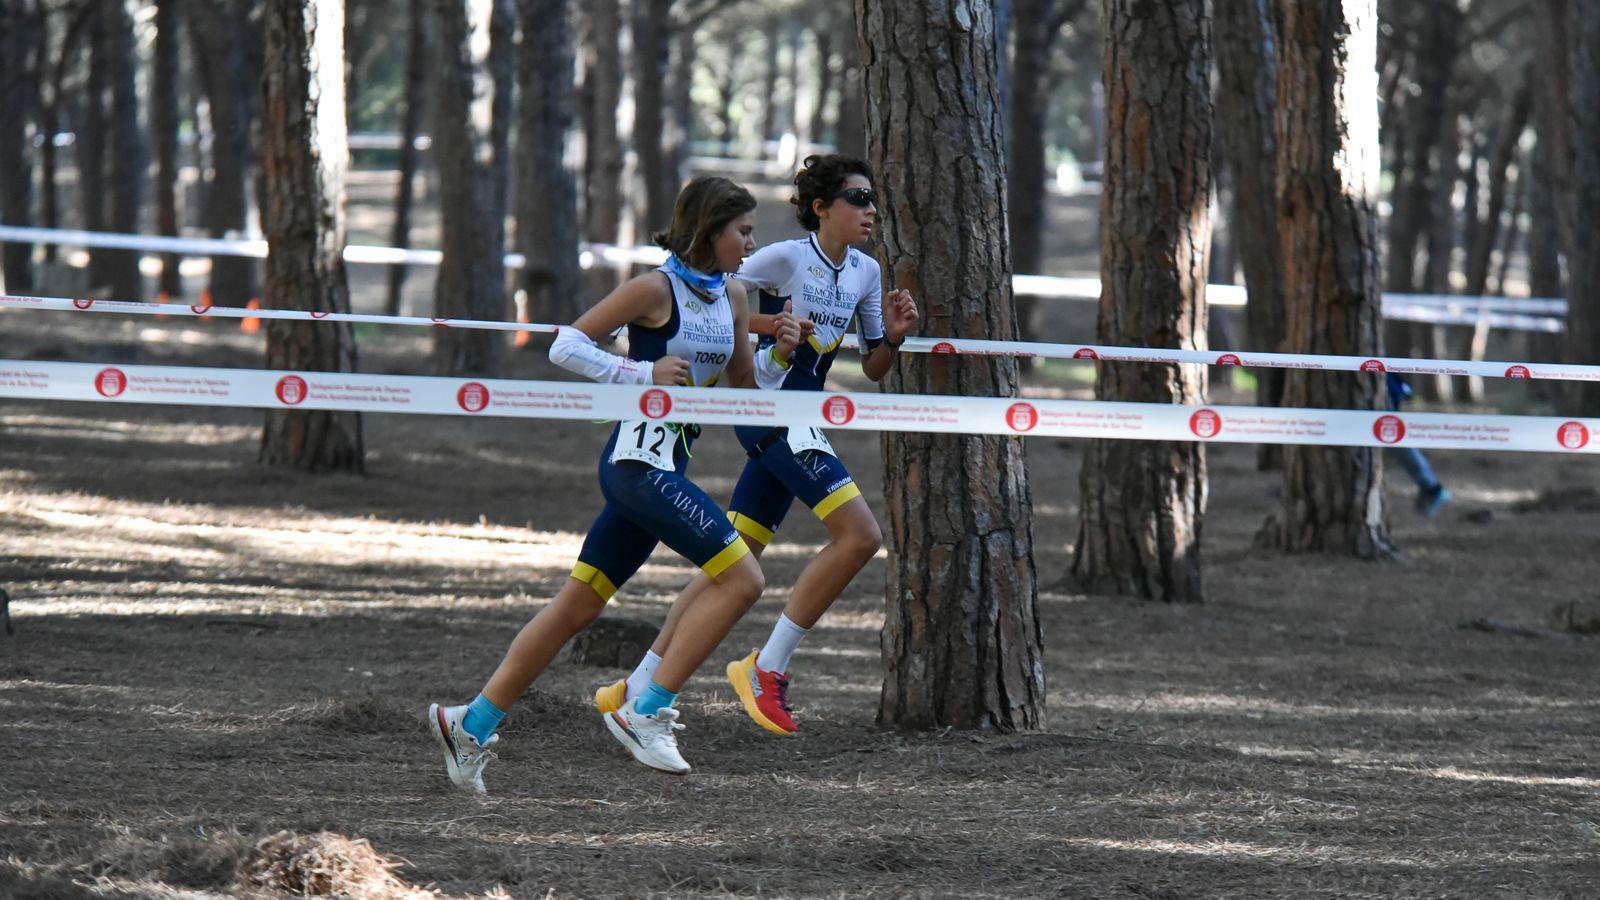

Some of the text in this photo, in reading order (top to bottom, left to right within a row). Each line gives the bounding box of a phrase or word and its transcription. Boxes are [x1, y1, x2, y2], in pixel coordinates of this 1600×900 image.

[814, 288, 858, 302] MONTEROS
[808, 311, 848, 329] NÚÑEZ
[695, 351, 727, 365] TORO
[633, 421, 666, 457] 12
[661, 482, 718, 535] CABANE
